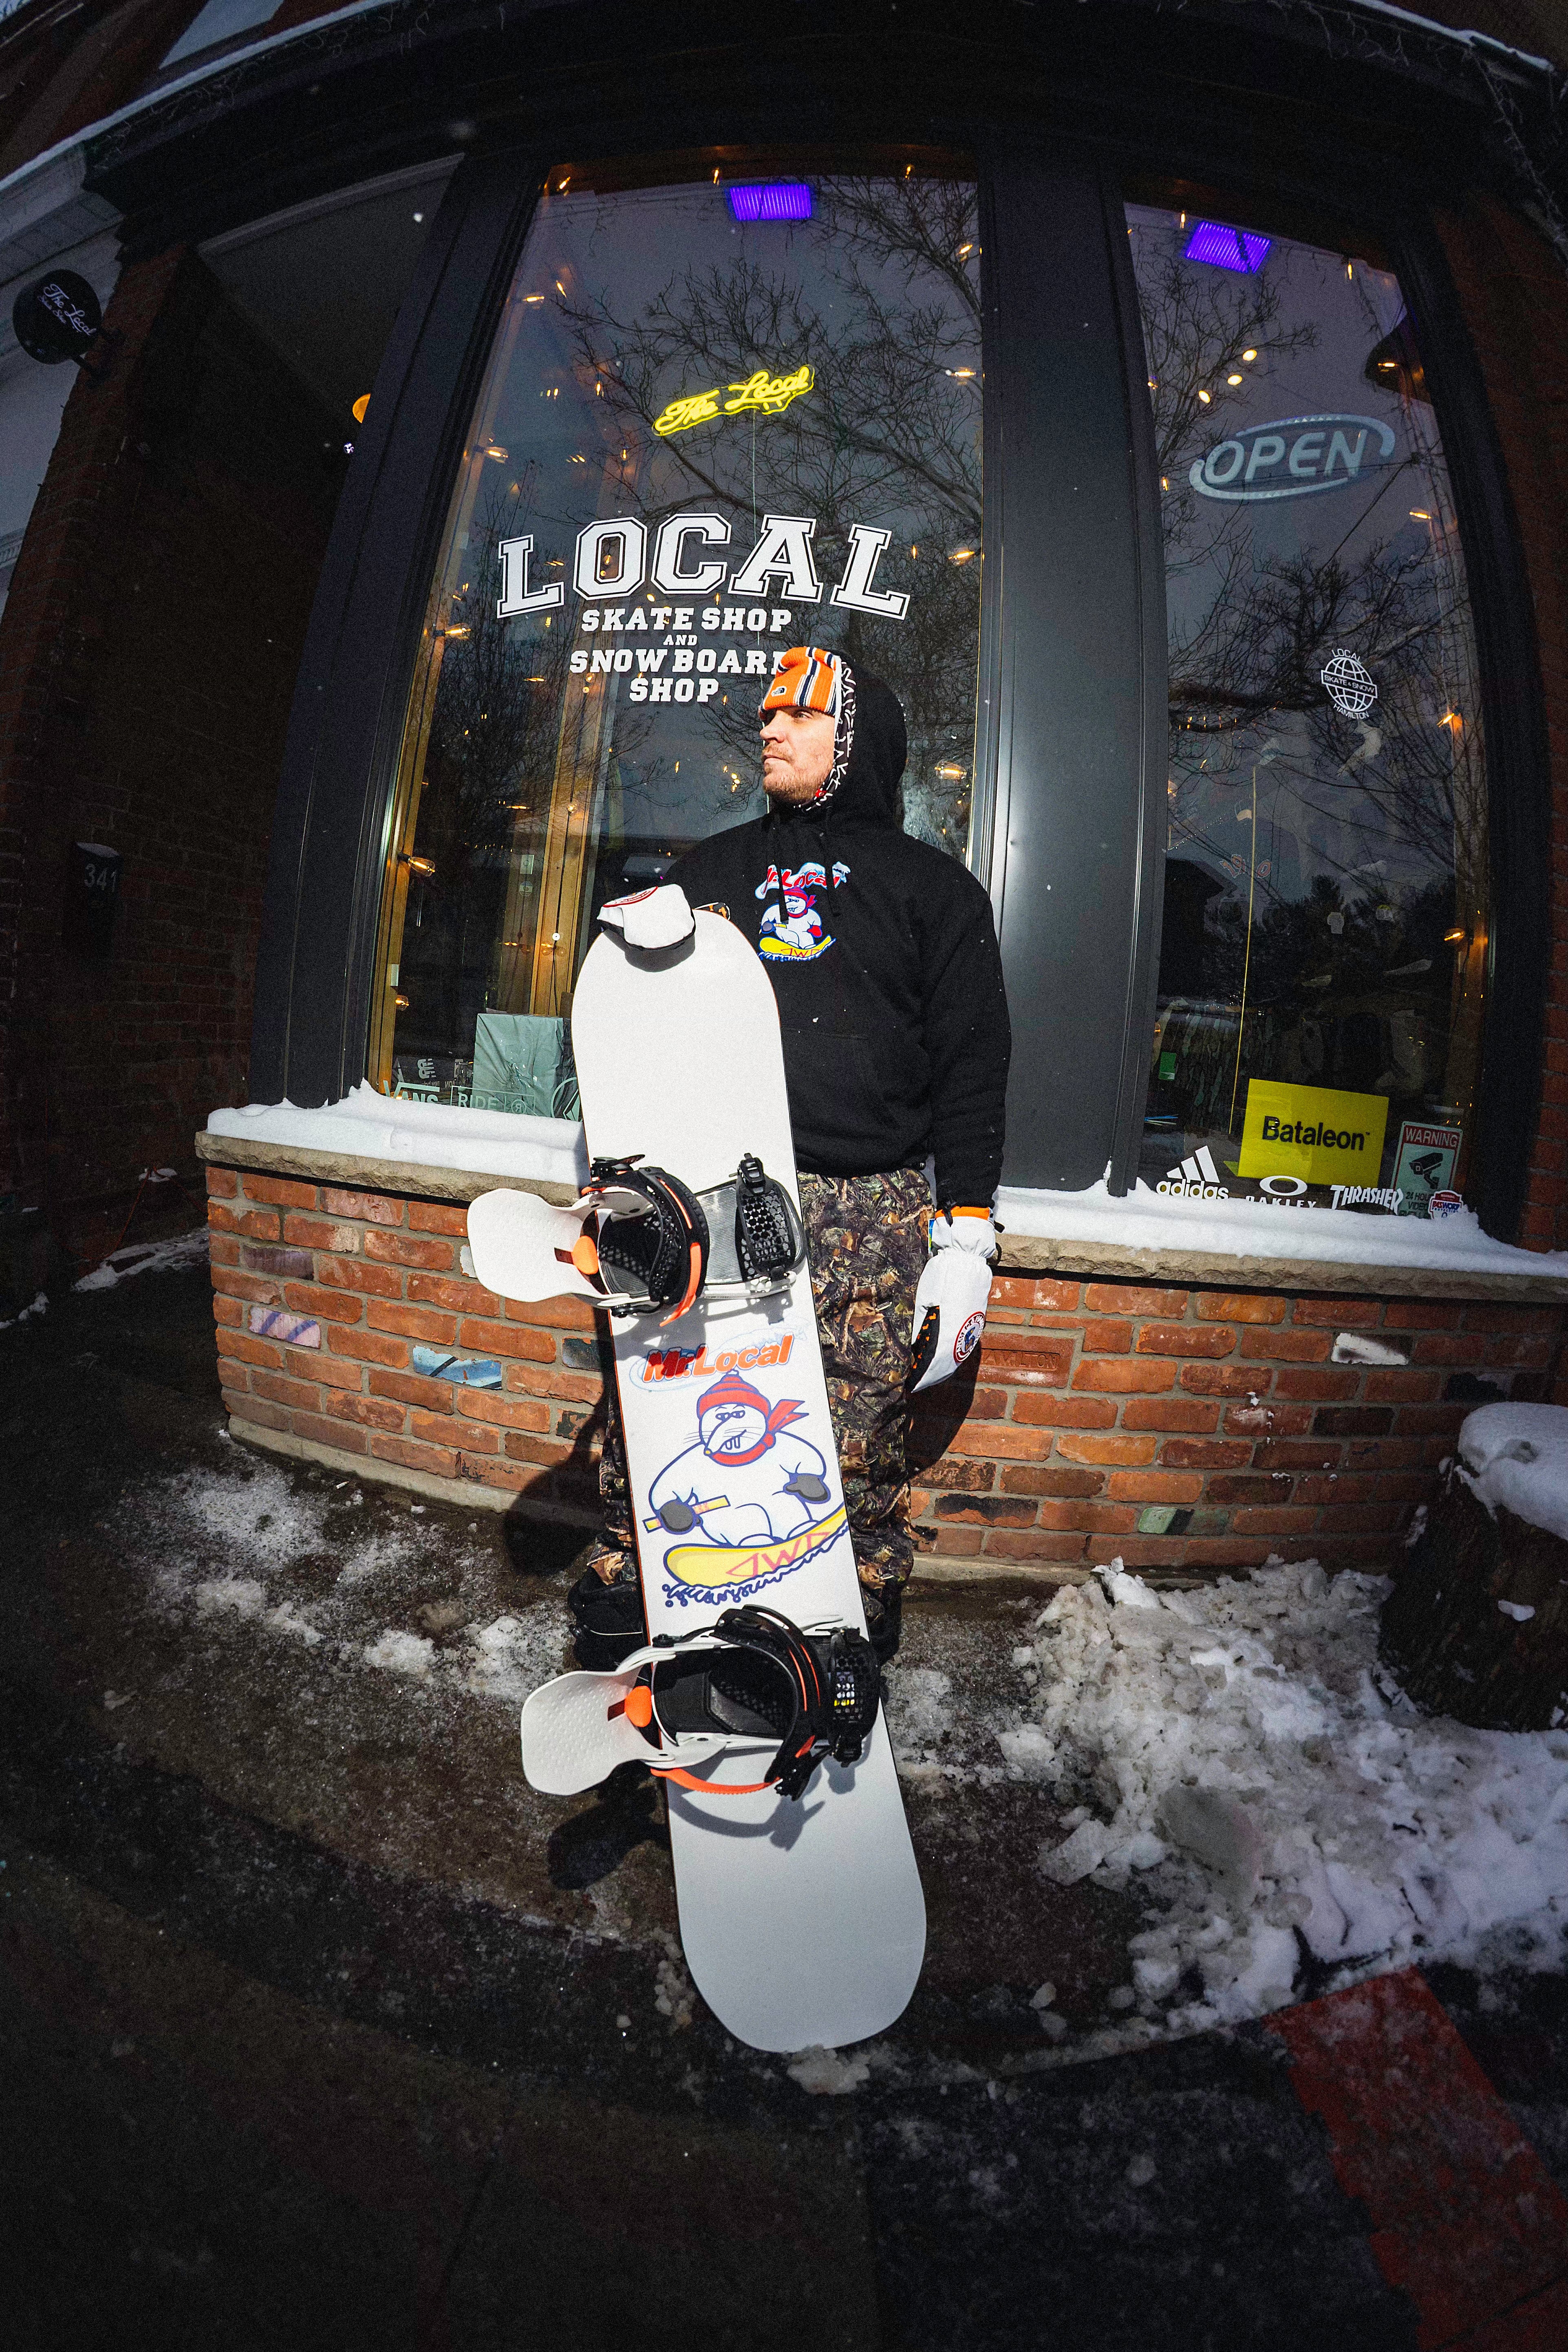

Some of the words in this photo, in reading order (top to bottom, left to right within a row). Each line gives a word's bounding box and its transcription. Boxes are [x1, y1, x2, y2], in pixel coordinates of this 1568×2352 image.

[44, 284, 69, 308] The
[64, 304, 97, 335] Local
[655, 389, 720, 432] The
[724, 366, 810, 410] Local
[1204, 429, 1368, 484] OPEN
[497, 513, 911, 620] LOCAL
[581, 607, 694, 632] SKATE
[701, 607, 792, 632] SHOP
[663, 634, 697, 646] AND
[1332, 649, 1363, 664] LOCAL
[629, 678, 719, 702] SHOP
[1325, 675, 1347, 686] SKATE
[1352, 682, 1374, 693] SNOW
[1333, 703, 1369, 719] HAMILTON
[84, 863, 117, 893] 341
[458, 1092, 498, 1110] RIDE
[1262, 1115, 1365, 1151] Bataleon
[1406, 1126, 1459, 1148] WARNING
[1156, 1178, 1229, 1200] adidas
[1330, 1185, 1404, 1216] THRASHER
[1405, 1191, 1414, 1200] 24
